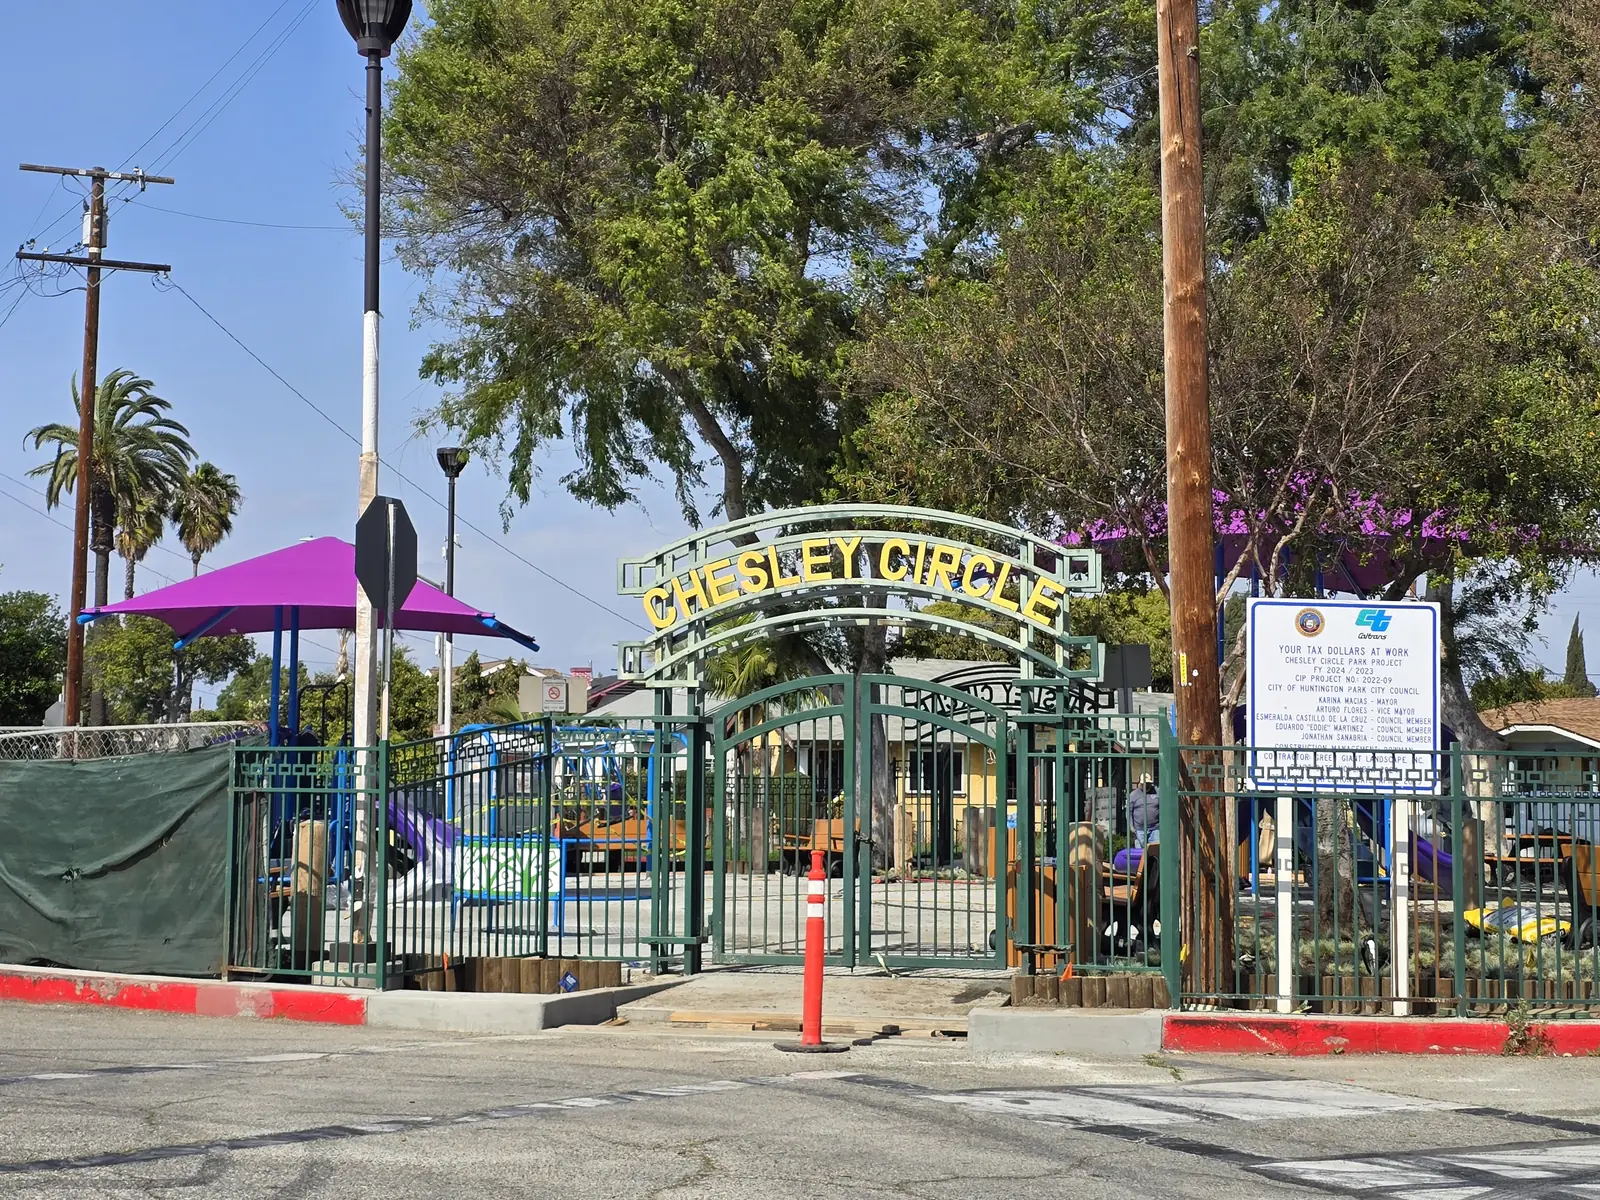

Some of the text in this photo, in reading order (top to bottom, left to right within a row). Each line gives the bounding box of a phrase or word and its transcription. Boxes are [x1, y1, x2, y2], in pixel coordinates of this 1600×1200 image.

[643, 536, 1067, 629] CHESLEY CIRCLE
[1358, 632, 1387, 640] Caltrans
[1279, 645, 1409, 657] YOUR TAX DOLLARS AT WORK
[1285, 656, 1402, 667] CHESLEY CIRCLE PARK PROJECT
[1313, 666, 1322, 674] FY
[1327, 666, 1345, 674] 2024
[1355, 667, 1374, 675] 2023
[1295, 674, 1306, 682] CIP
[1310, 674, 1341, 683] PROJECT
[1363, 676, 1393, 684] 2022-09
[1268, 683, 1419, 695] CITY OF HUNTINGTON PARK CITY COUNCIL
[1318, 696, 1341, 704] KARINA
[1344, 697, 1368, 705] MACIAS
[1377, 698, 1398, 706] MAYOR
[1316, 705, 1341, 714] ARTURO
[1344, 706, 1368, 714] FLORES
[1377, 707, 1391, 715] VICE
[1394, 707, 1415, 716] MAYOR
[1256, 713, 1293, 721] ESMERALDA
[1296, 714, 1326, 722] CASTILLO
[1328, 715, 1337, 723] DE
[1340, 715, 1348, 723] LA
[1351, 716, 1368, 724] CRUZ
[1377, 716, 1403, 725] COUNCIL
[1406, 717, 1432, 725] MEMBER
[1275, 722, 1304, 731] EDUARDO
[1333, 724, 1364, 733] MARTINEZ
[1377, 725, 1403, 734] COUNCIL
[1406, 726, 1432, 735] MEMBER
[1301, 733, 1333, 741] JONATHAN
[1336, 734, 1368, 742] SANABRIA
[1377, 734, 1403, 743] COUNCIL
[1406, 735, 1432, 744] MEMBER
[1264, 752, 1311, 761] COTRACTOR:
